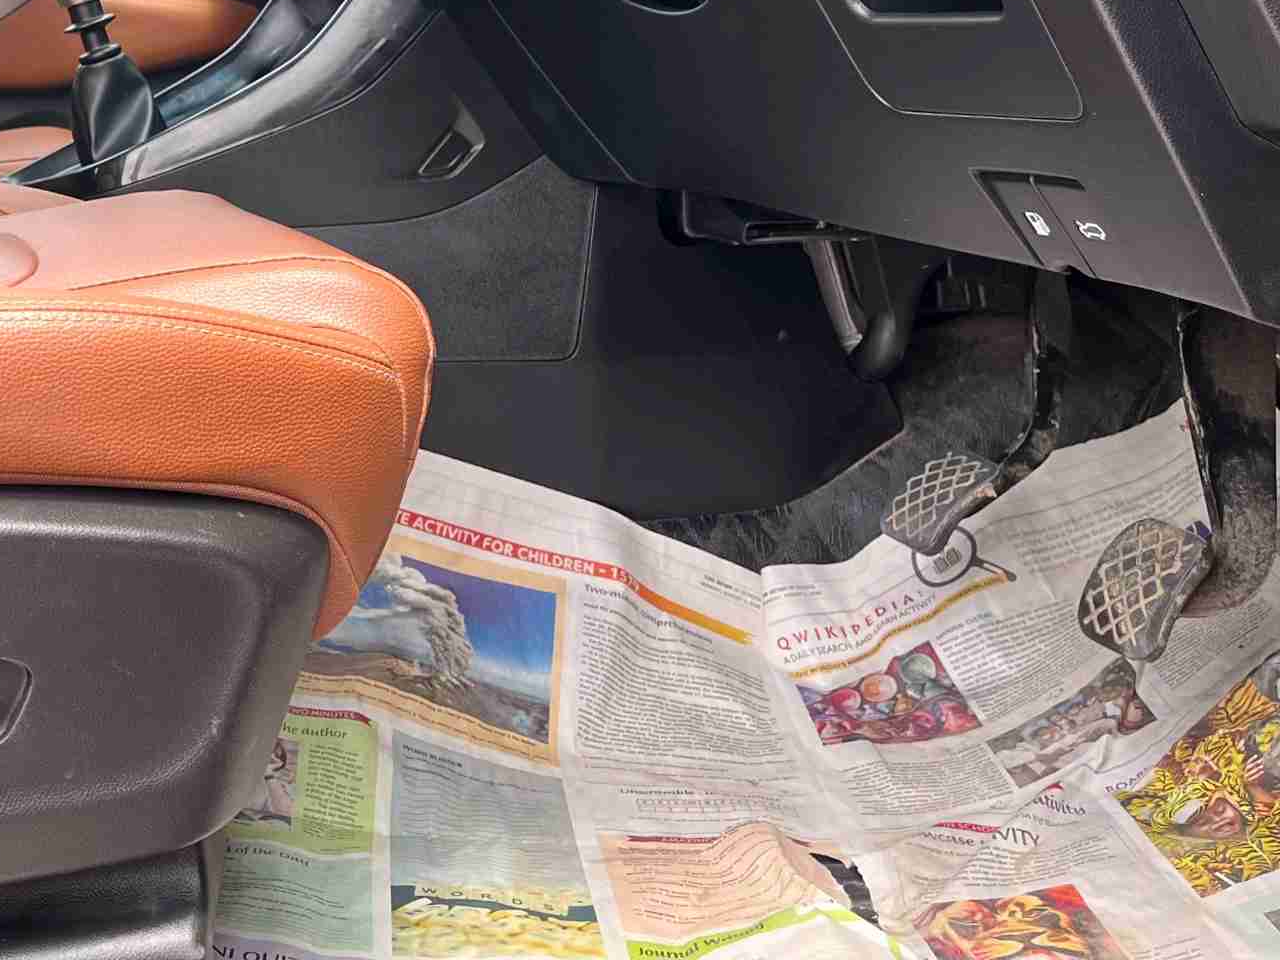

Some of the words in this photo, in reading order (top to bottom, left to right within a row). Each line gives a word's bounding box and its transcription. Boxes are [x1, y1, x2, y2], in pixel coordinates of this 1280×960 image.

[412, 515, 481, 546] ACTIVITY
[482, 536, 514, 558] FOR
[516, 546, 595, 576] CHILDREN
[776, 594, 915, 651] QWIKIPEDIA
[301, 726, 349, 739] author
[639, 942, 700, 960] Journal
